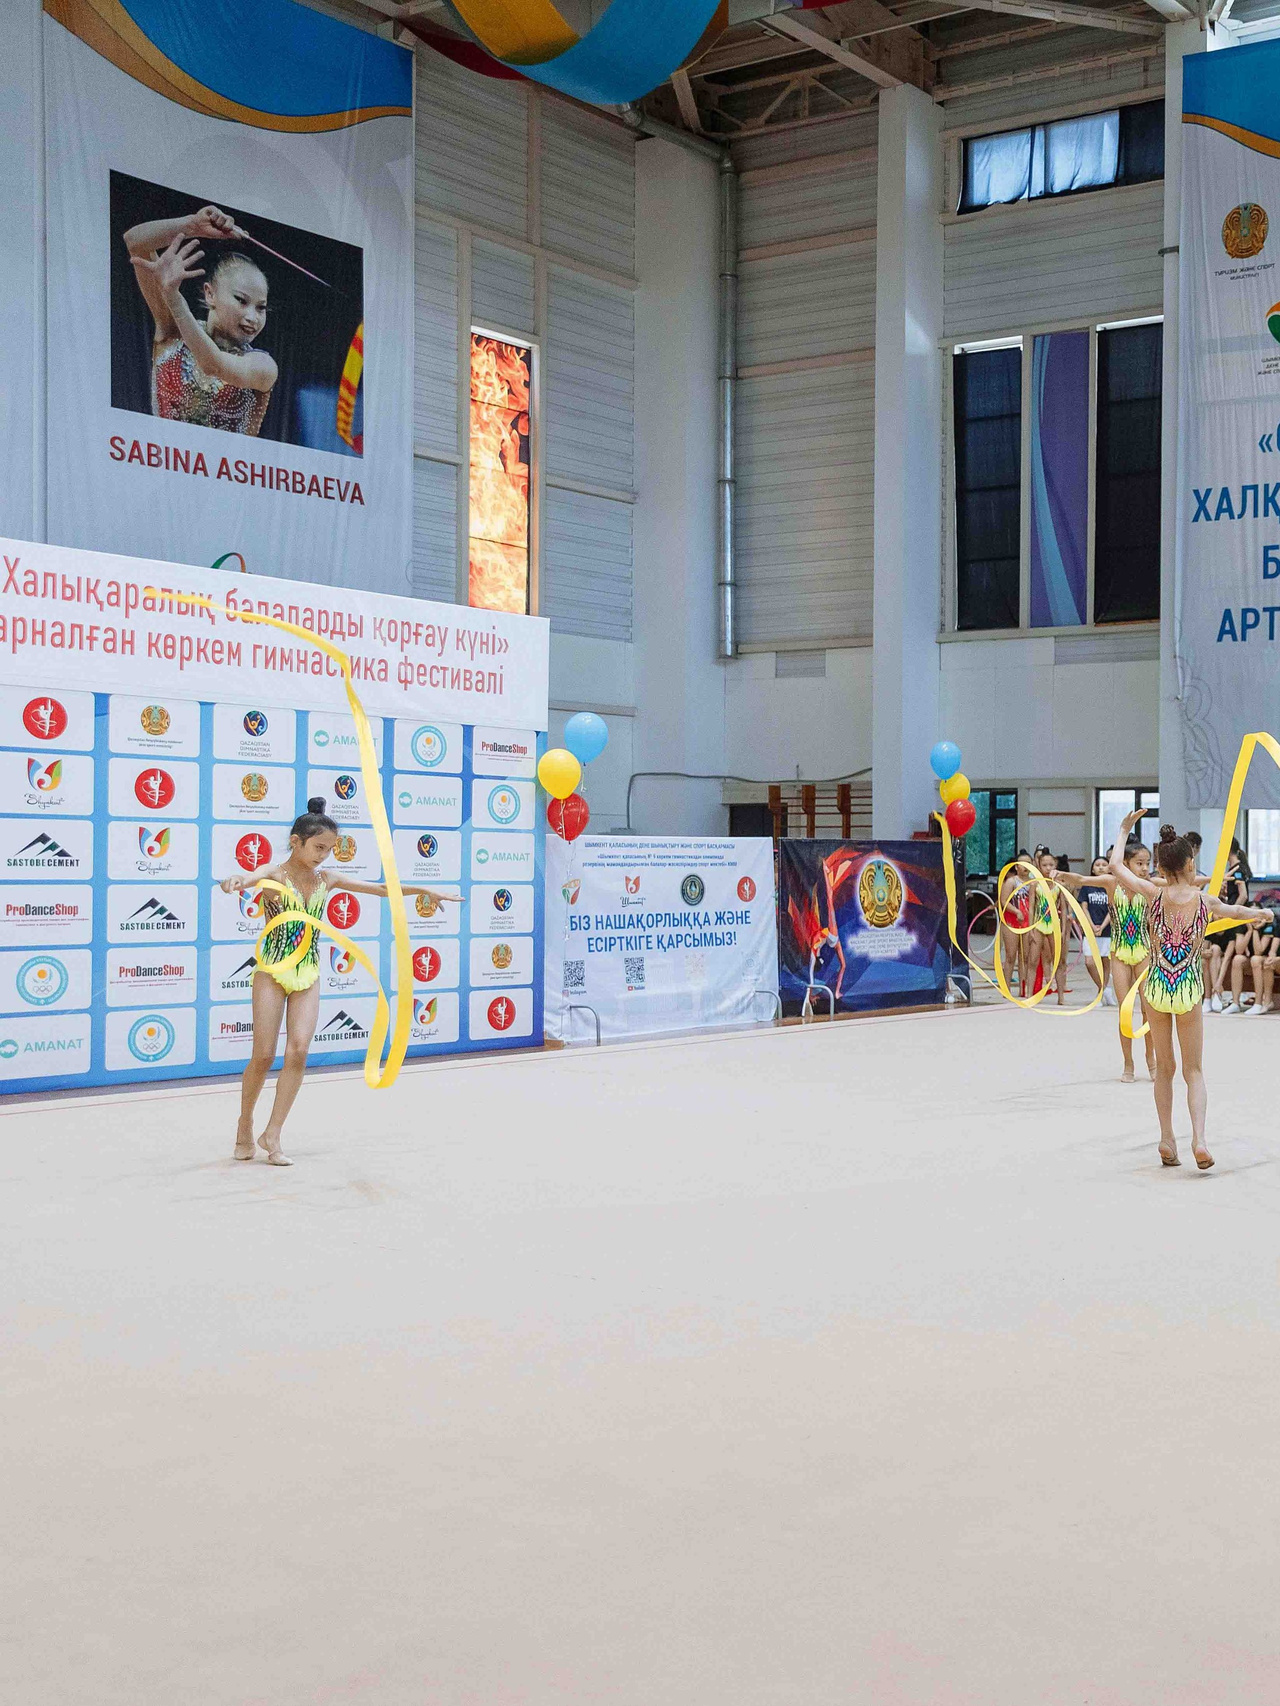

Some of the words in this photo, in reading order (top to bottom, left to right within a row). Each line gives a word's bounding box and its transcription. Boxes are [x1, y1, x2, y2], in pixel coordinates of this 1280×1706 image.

[109, 435, 209, 478] SABINA
[216, 458, 365, 506] ASHIRBAEVA
[2, 555, 216, 625] Халықаралық
[225, 588, 363, 642] балаларды
[373, 617, 449, 657] қорғау
[456, 625, 510, 661] күні»
[147, 632, 242, 670] көркем
[252, 643, 389, 683] гимнасика
[397, 655, 505, 695] фестивалі
[333, 735, 378, 748] AMAT
[481, 741, 528, 755] ProDanceShop
[416, 797, 457, 807] AMANAT
[7, 858, 46, 867] SASTOBE
[47, 858, 80, 867] CEMENT
[492, 852, 531, 862] AMANAT
[6, 903, 79, 917] ProDanceShop
[120, 922, 155, 931] SASTOBE
[156, 921, 186, 930] CEMENT
[569, 915, 591, 931] БІЗ
[595, 911, 711, 932] НАШАҚОРЛЫҚҚА
[714, 910, 751, 926] ЖӘНЕ
[588, 935, 653, 953] ЕСІРТКІГЕ
[657, 931, 737, 952] ҚАРСЫМЫЗ!
[119, 964, 185, 977] ProDanceShop
[314, 1033, 343, 1042] SASTOBE
[344, 1031, 369, 1040] CEMENT
[23, 1038, 84, 1053] AMANAT
